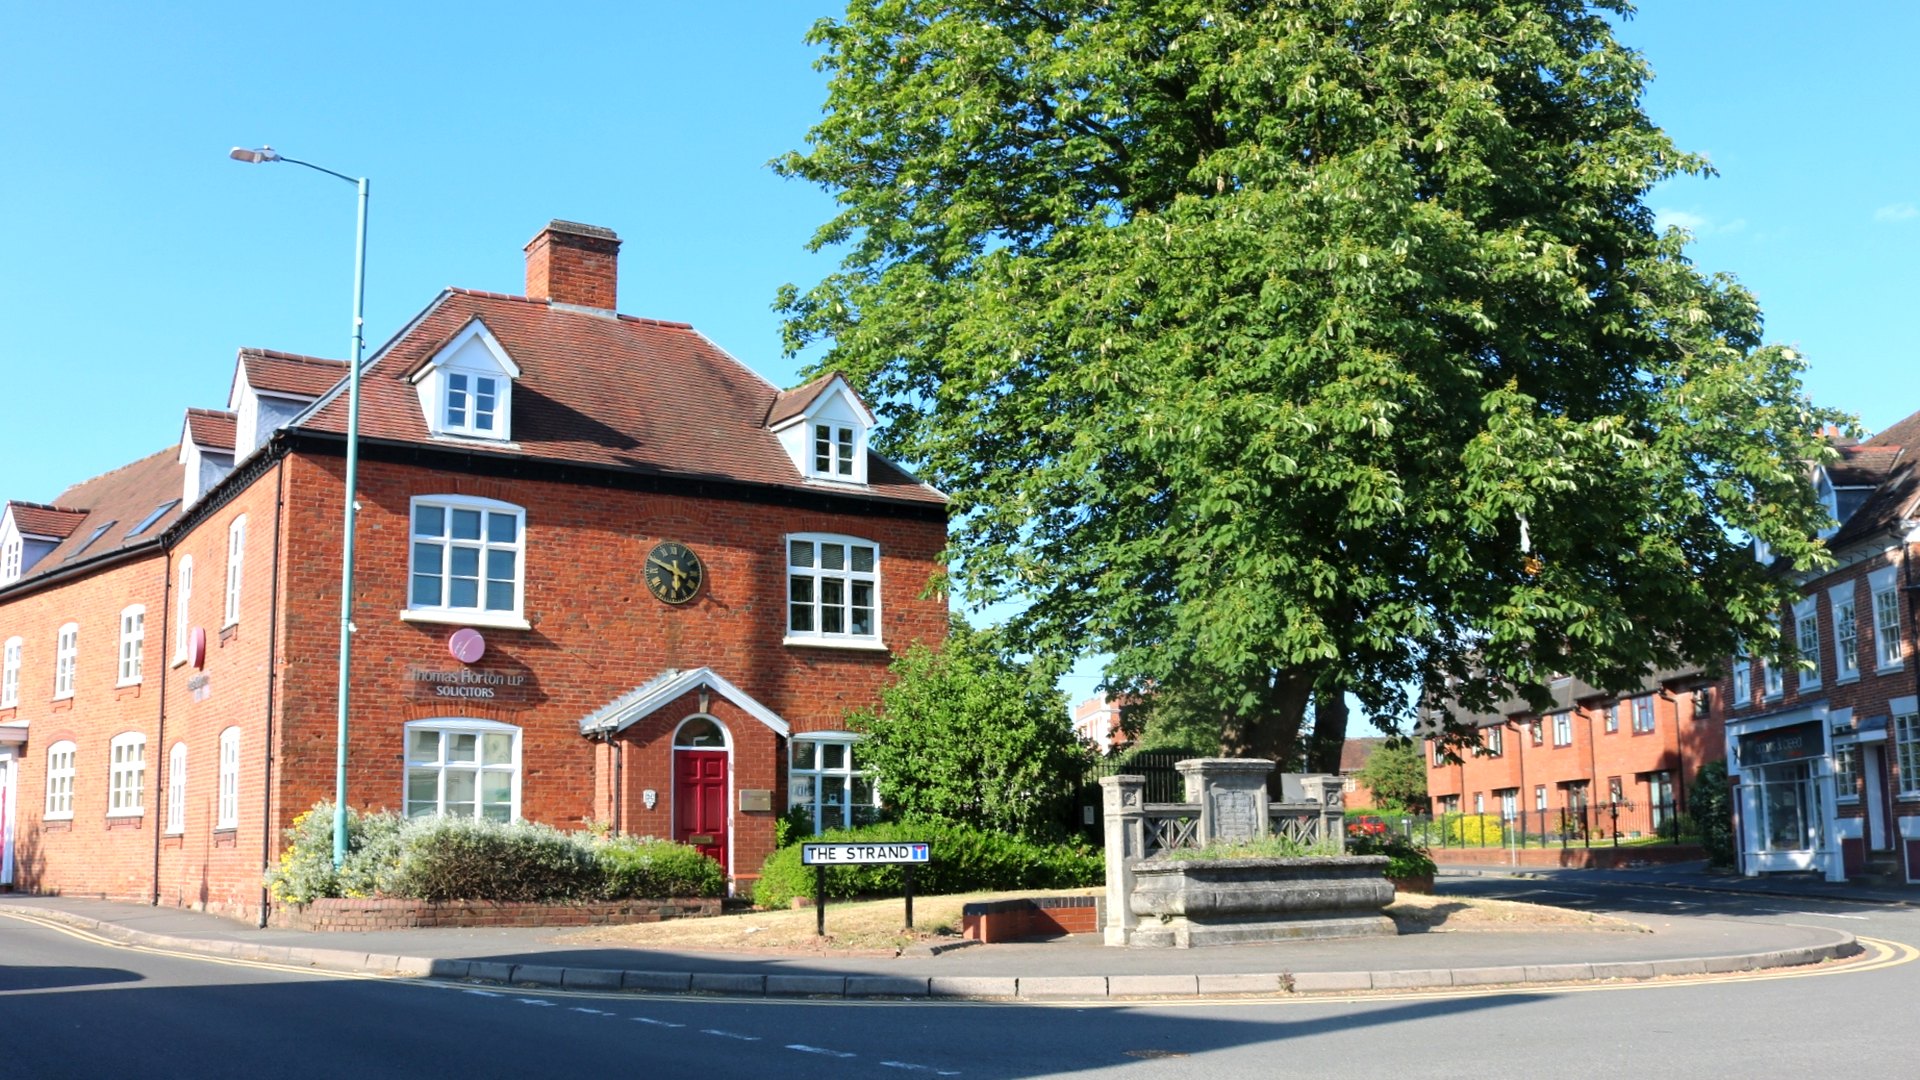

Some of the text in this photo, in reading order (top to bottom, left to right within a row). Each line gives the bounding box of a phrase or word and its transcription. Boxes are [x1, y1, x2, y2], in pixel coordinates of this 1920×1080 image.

[461, 669, 503, 685] Horton
[507, 675, 524, 686] LLP
[436, 685, 494, 698] SOLICITORS
[808, 846, 909, 860] THE STRAND
